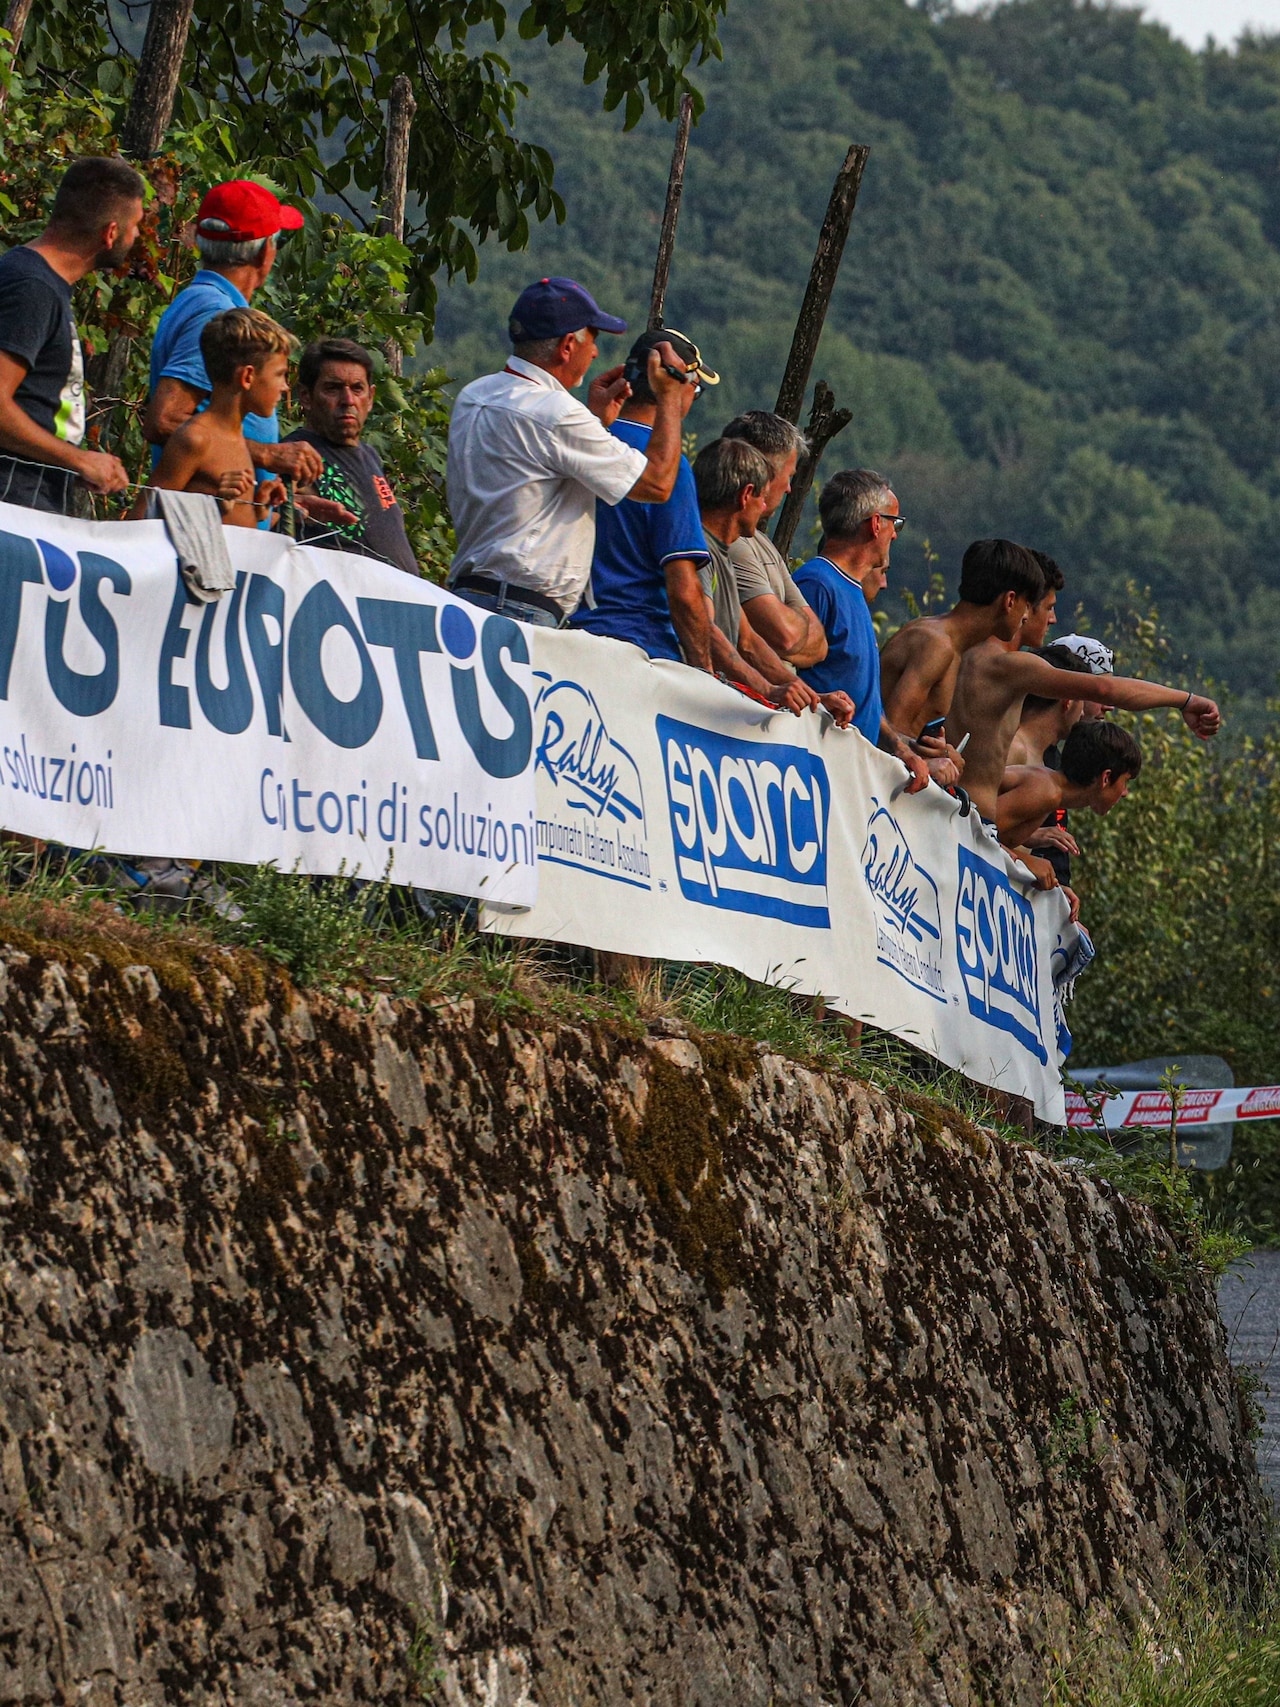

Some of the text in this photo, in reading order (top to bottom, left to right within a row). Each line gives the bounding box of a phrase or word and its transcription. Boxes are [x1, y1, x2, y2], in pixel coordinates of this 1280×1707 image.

[4, 734, 114, 809] soluzioni
[534, 710, 619, 818] Rally
[378, 782, 407, 844] di
[419, 791, 535, 867] soluzioni
[536, 814, 651, 879] mpionato Italiano Assoluto
[865, 833, 919, 935] Rally
[957, 866, 1037, 1015] sparco
[1128, 1108, 1183, 1124] DANGEROS
